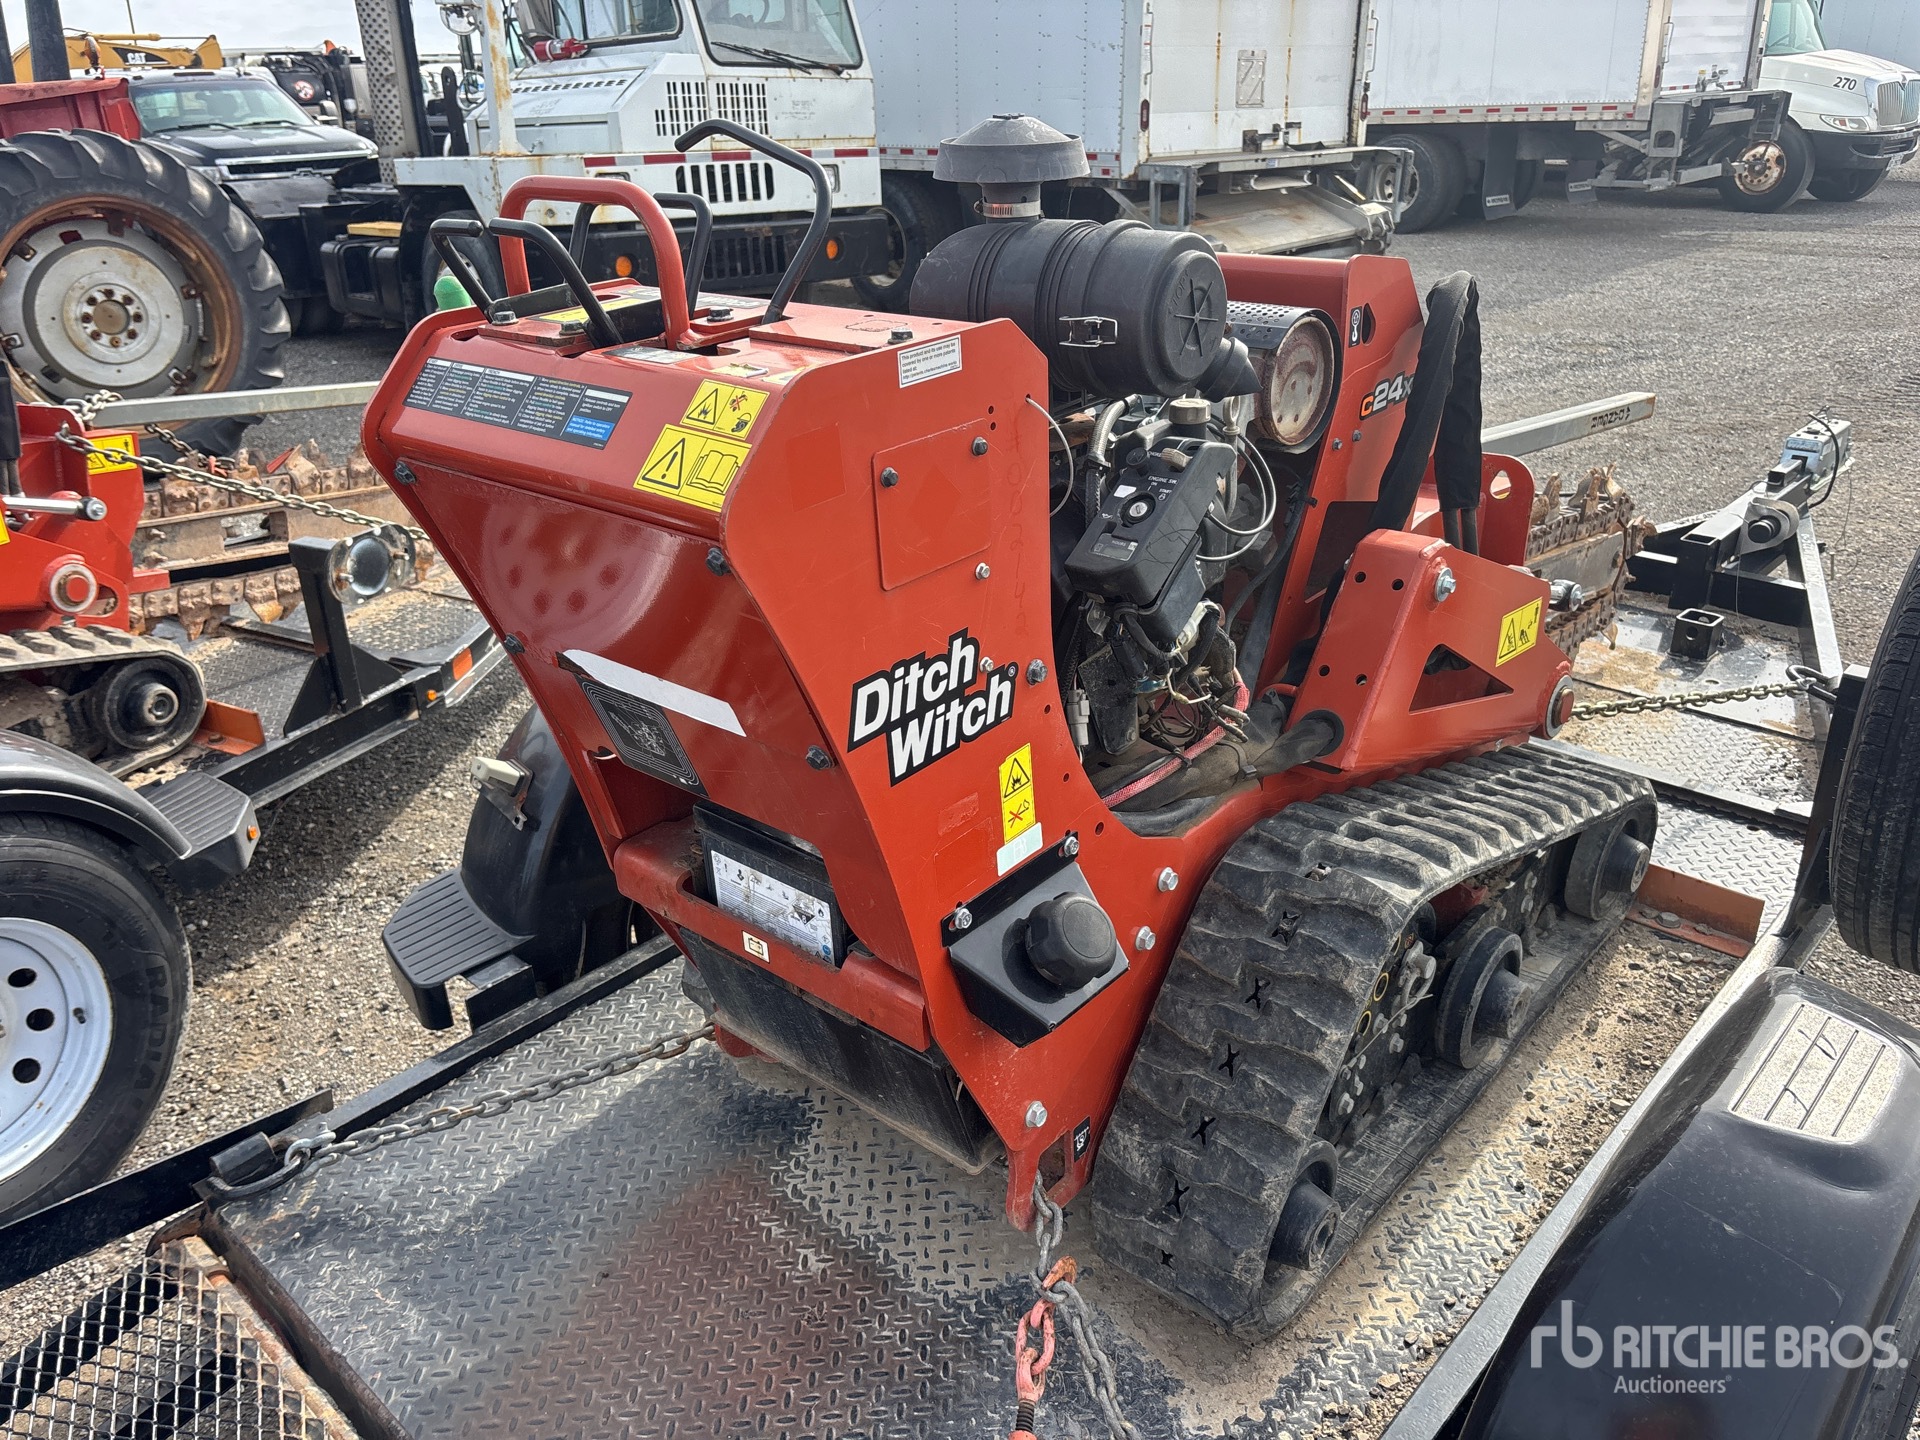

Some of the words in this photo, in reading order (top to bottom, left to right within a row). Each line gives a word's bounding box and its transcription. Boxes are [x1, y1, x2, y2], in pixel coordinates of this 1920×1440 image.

[127, 53, 146, 64] CAT
[1833, 76, 1857, 91] 270
[1591, 408, 1625, 429] DANGER
[1148, 475, 1168, 483] ENGINE
[853, 637, 975, 742] Ditch
